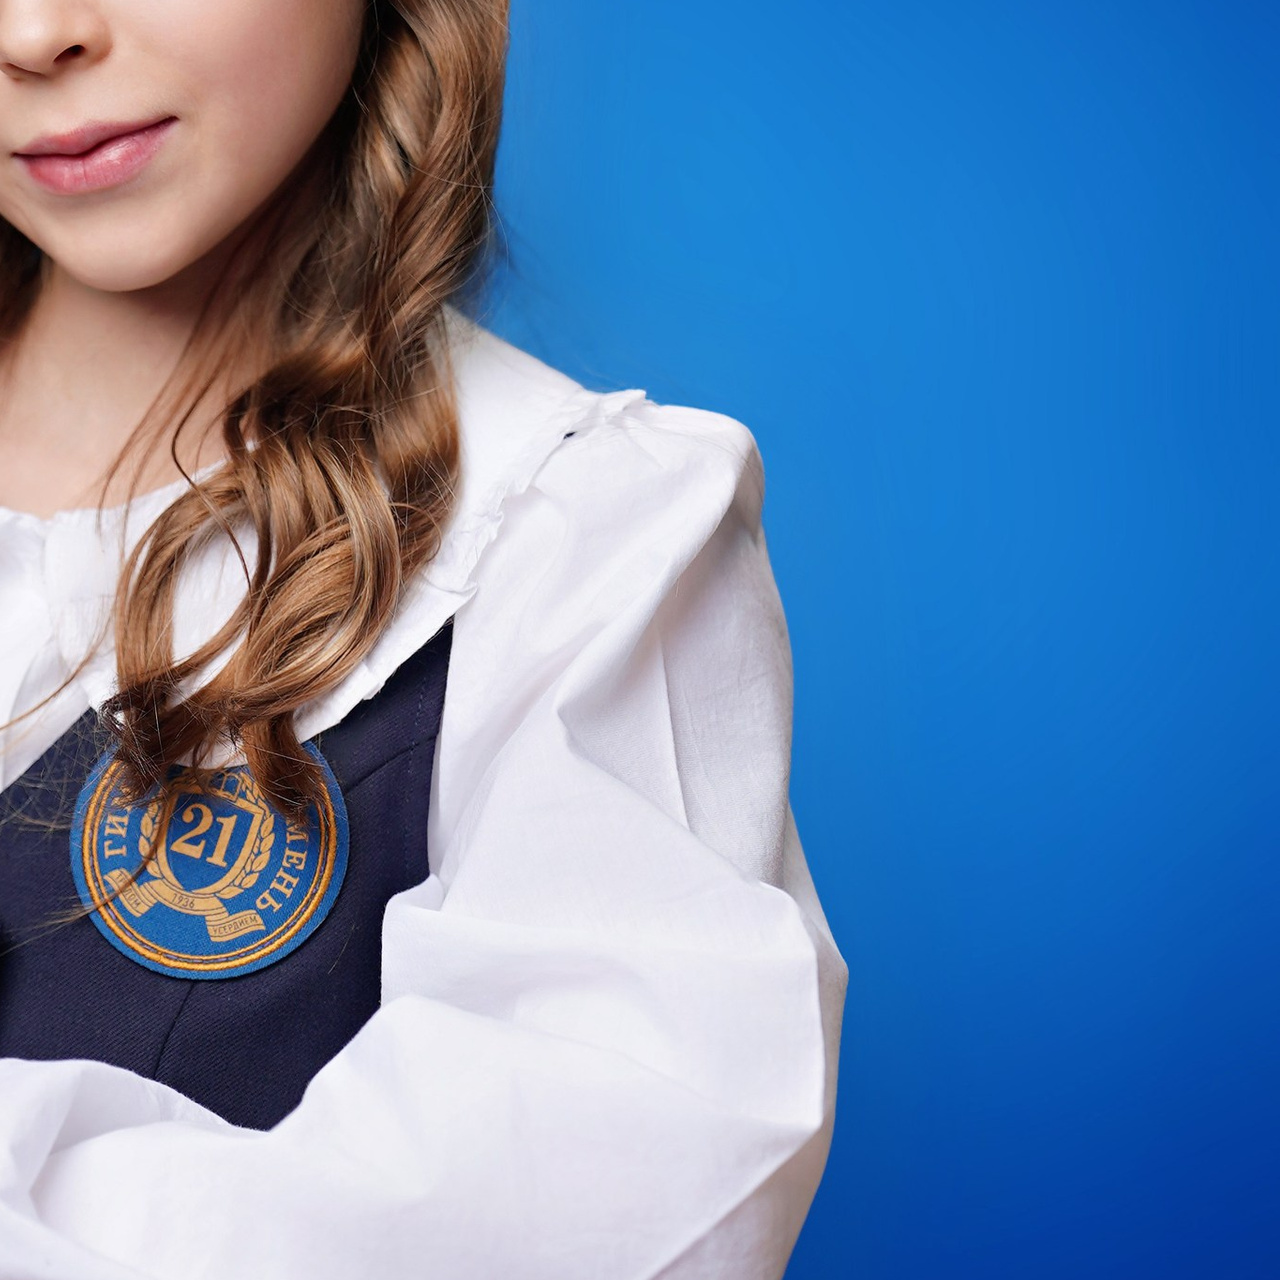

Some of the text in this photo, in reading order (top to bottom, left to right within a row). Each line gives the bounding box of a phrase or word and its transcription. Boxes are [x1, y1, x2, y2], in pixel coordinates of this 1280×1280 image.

[170, 803, 238, 867] 21
[171, 892, 195, 909] 1936
[213, 915, 258, 935] УСЕРДИЕМ
